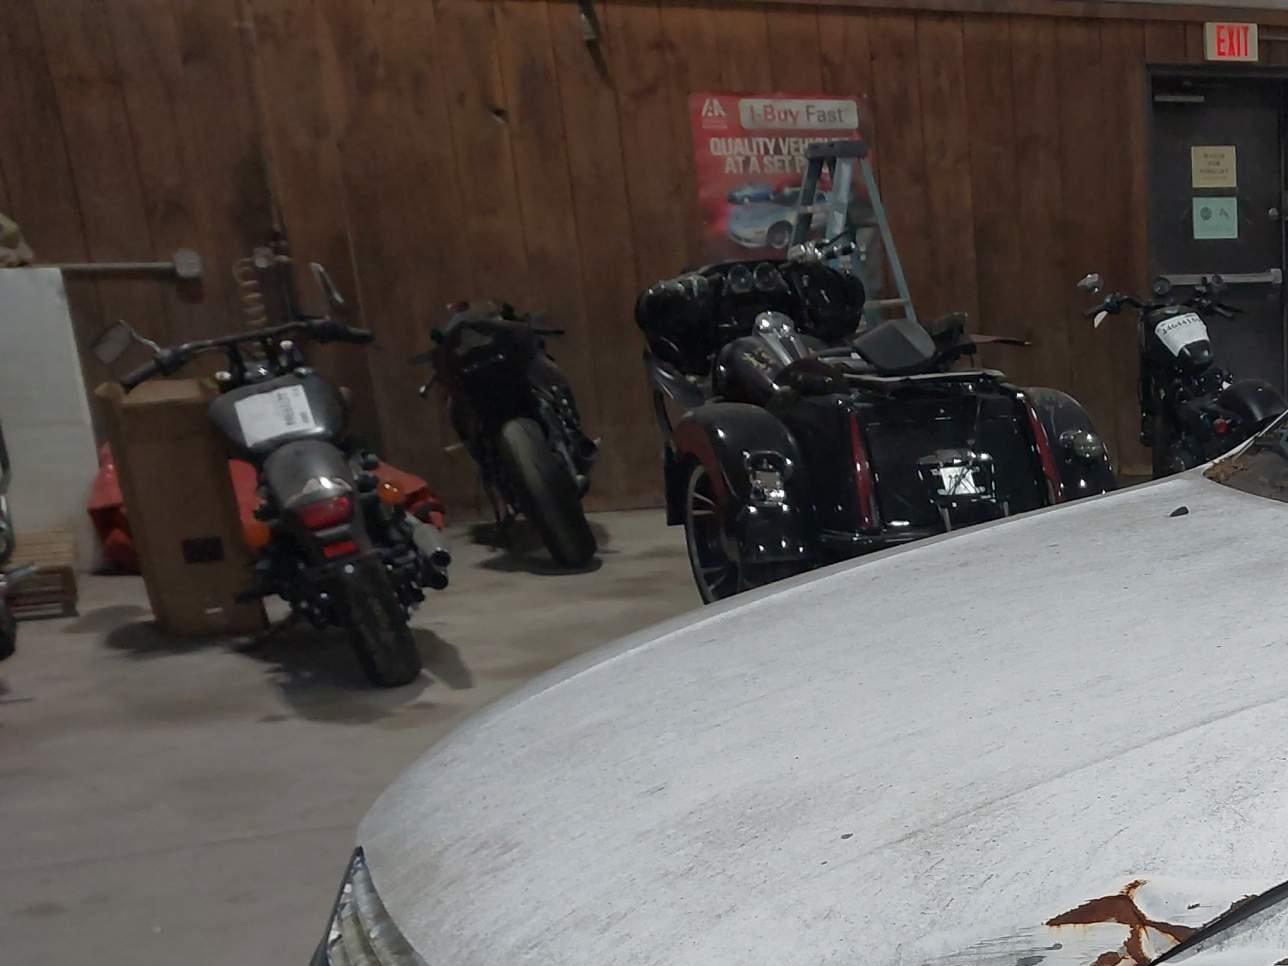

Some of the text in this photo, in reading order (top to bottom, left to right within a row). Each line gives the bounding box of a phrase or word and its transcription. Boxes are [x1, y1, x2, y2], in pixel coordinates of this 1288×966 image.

[1216, 24, 1249, 57] EXIT
[805, 104, 844, 123] Fast
[710, 136, 776, 156] QUALITY
[725, 156, 745, 174] AT
[749, 156, 761, 174] A
[763, 155, 794, 174] SET
